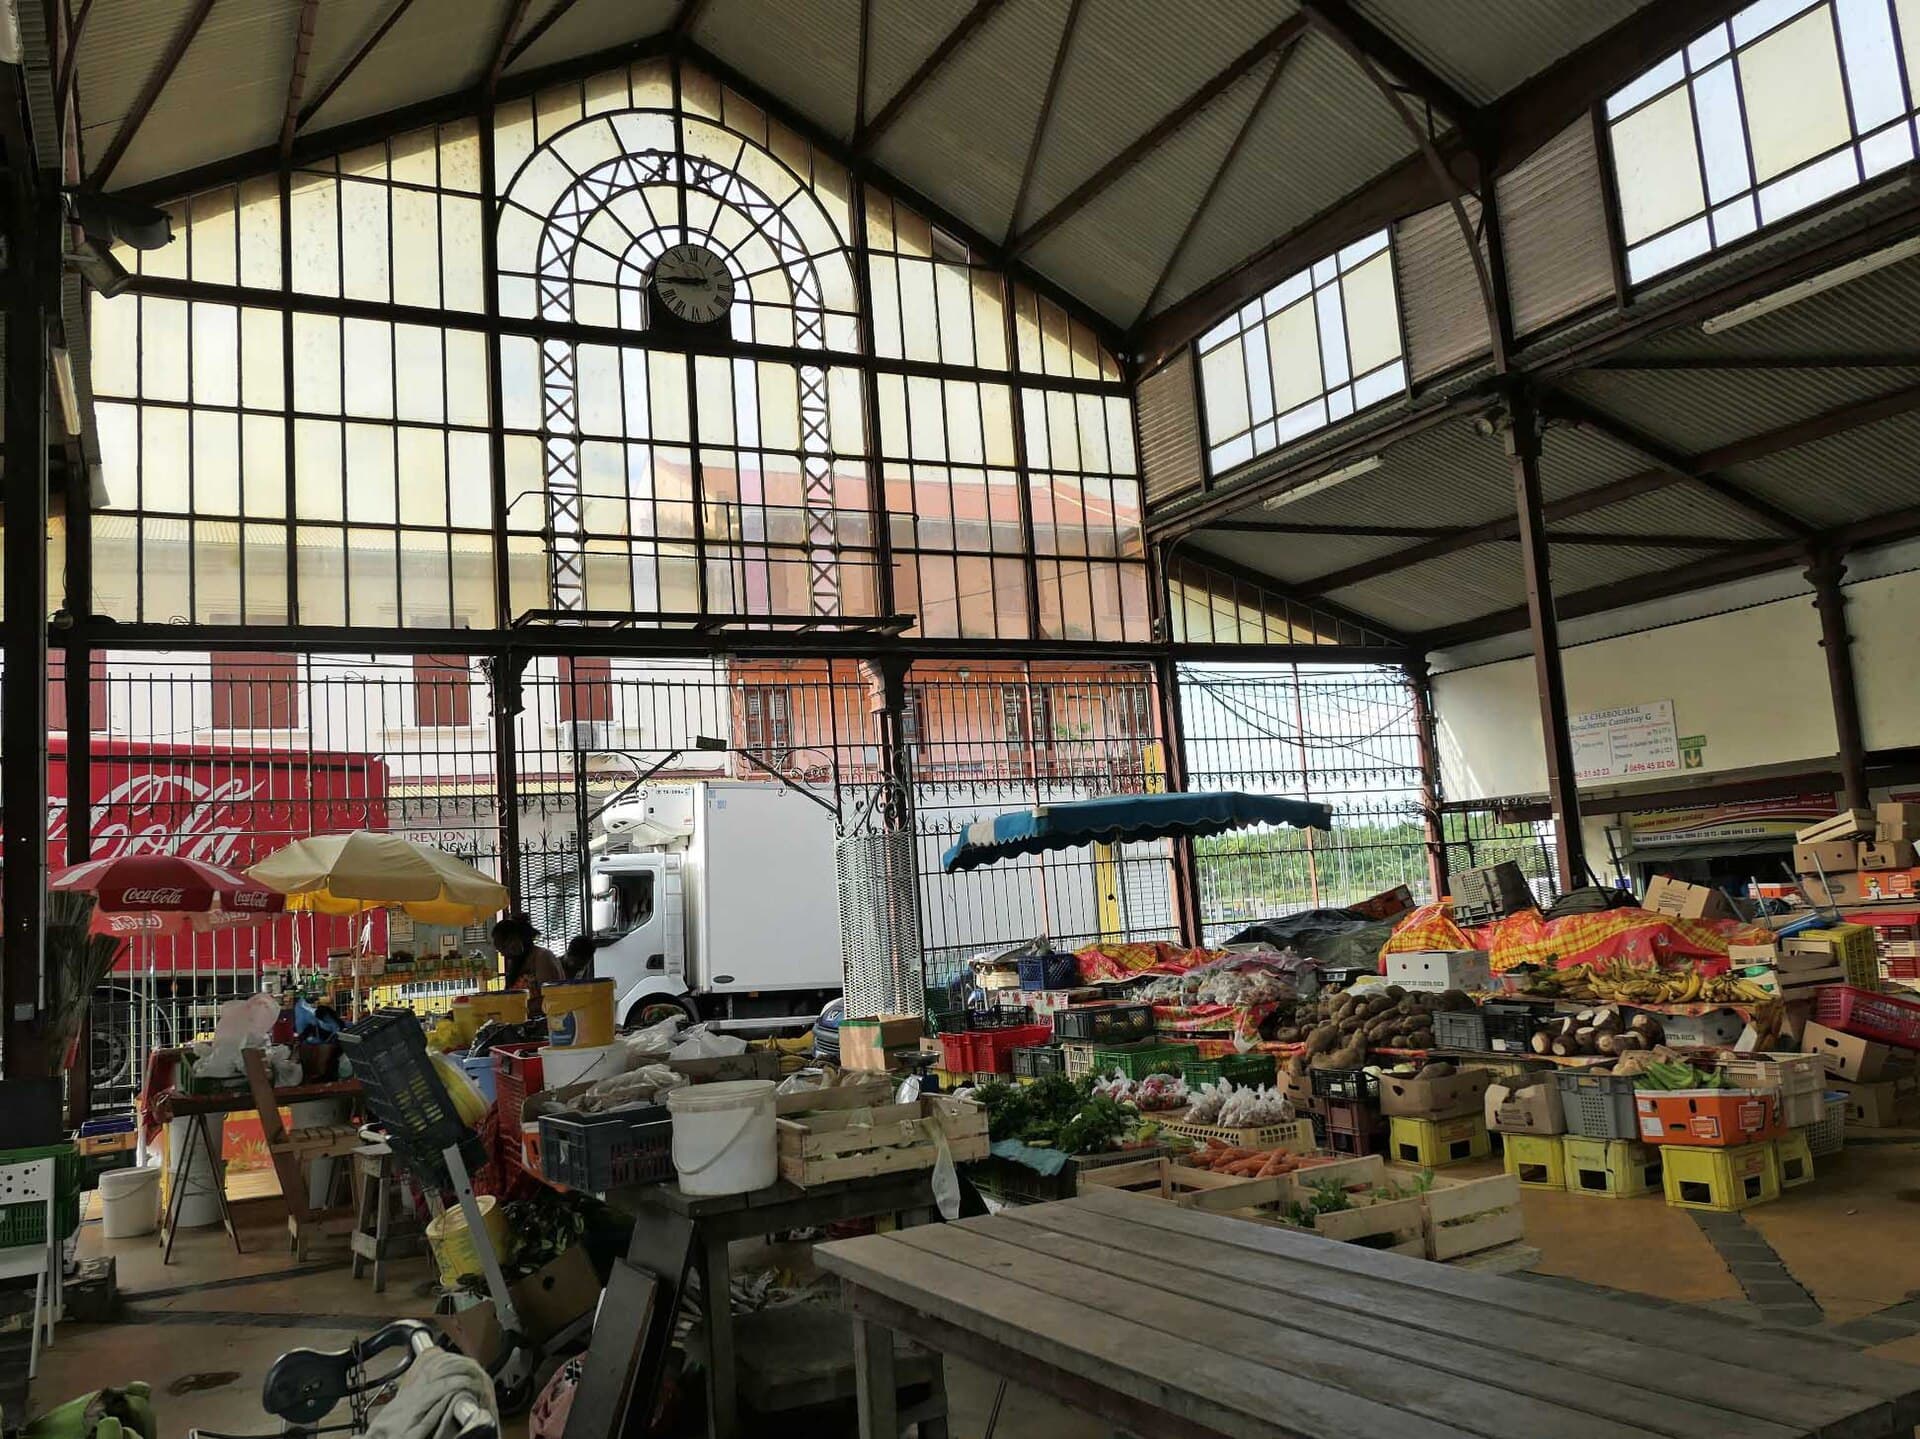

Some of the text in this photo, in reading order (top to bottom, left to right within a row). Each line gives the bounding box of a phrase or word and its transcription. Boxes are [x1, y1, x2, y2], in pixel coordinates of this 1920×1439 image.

[409, 831, 465, 843] REVON
[122, 887, 185, 905] Coca-Cola
[234, 890, 269, 908] Coca-Cola
